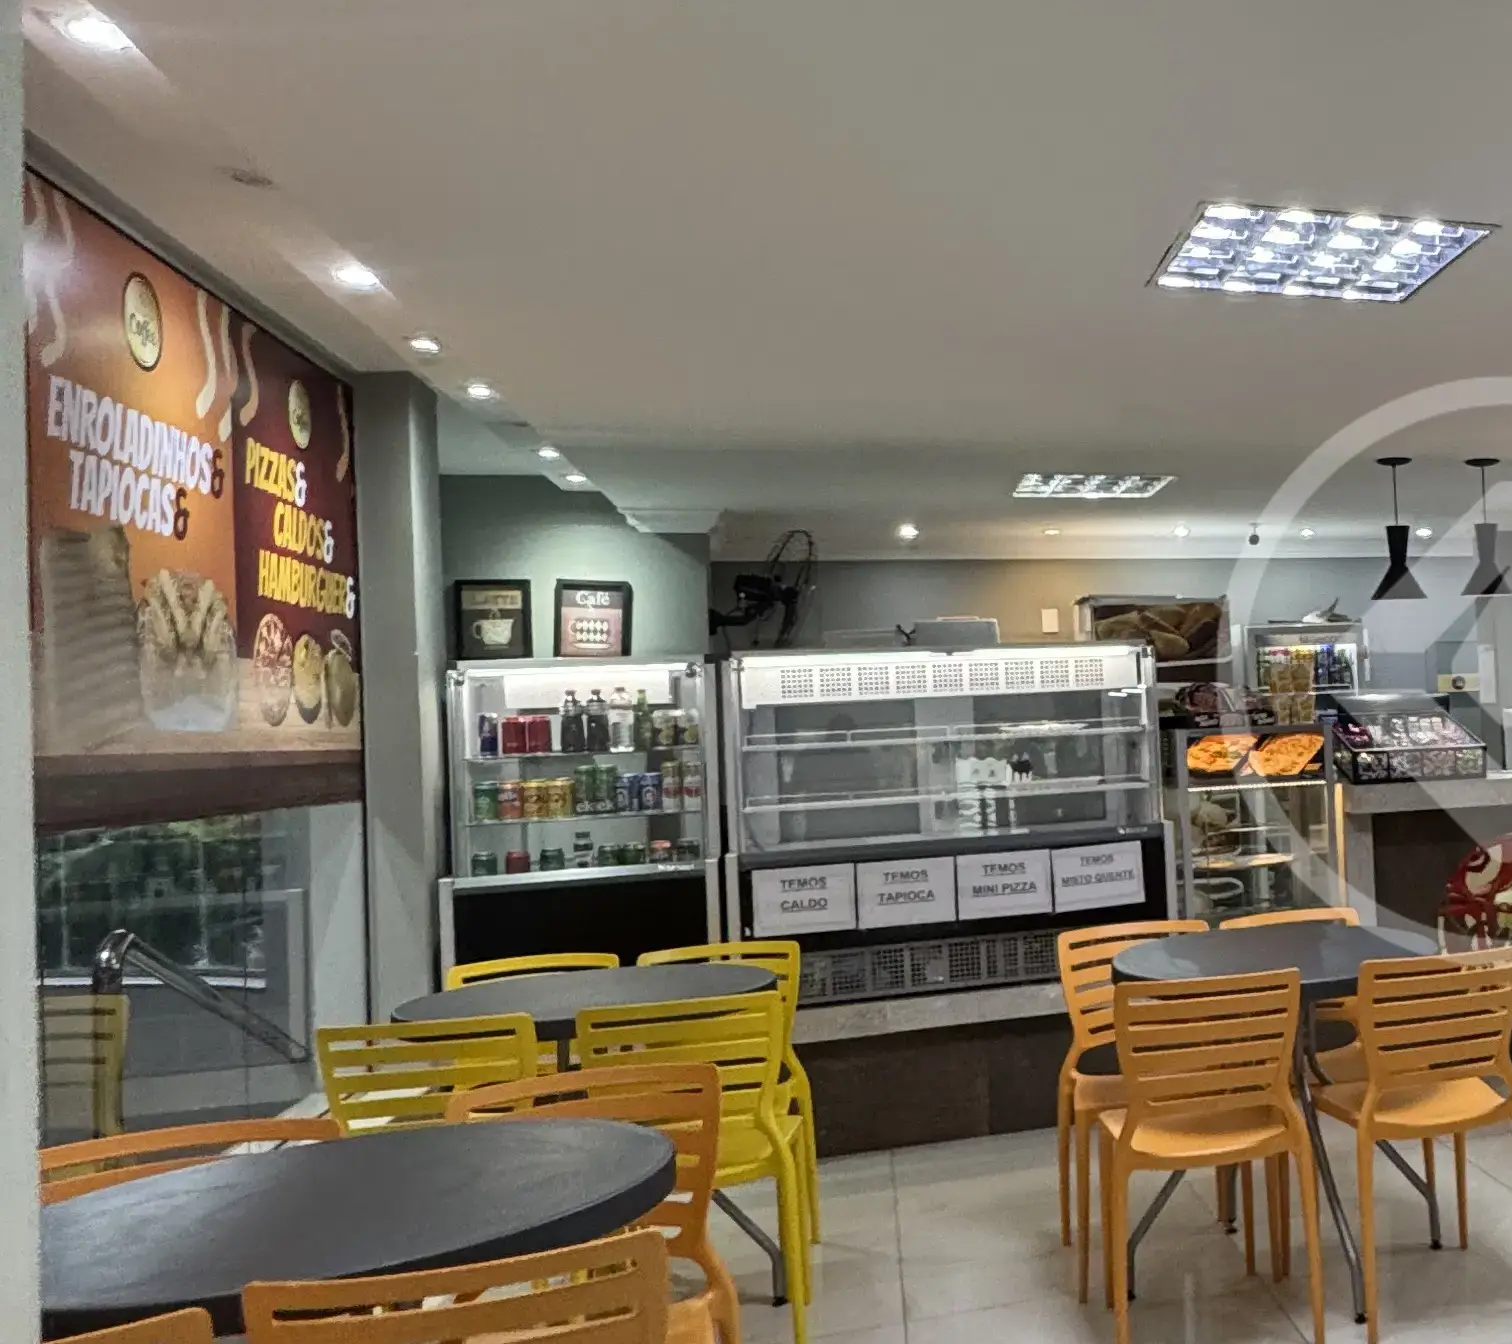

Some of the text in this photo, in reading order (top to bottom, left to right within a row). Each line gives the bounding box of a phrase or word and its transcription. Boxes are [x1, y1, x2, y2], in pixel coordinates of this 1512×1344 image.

[982, 862, 1026, 875] TEMOS
[1080, 854, 1114, 867] TEMOS
[780, 876, 828, 892] TEMOS
[883, 869, 929, 884] TEMOS
[972, 880, 1037, 896] MINI PIZZA
[780, 896, 828, 913] CALDO
[878, 889, 936, 905] TAPIOCA
